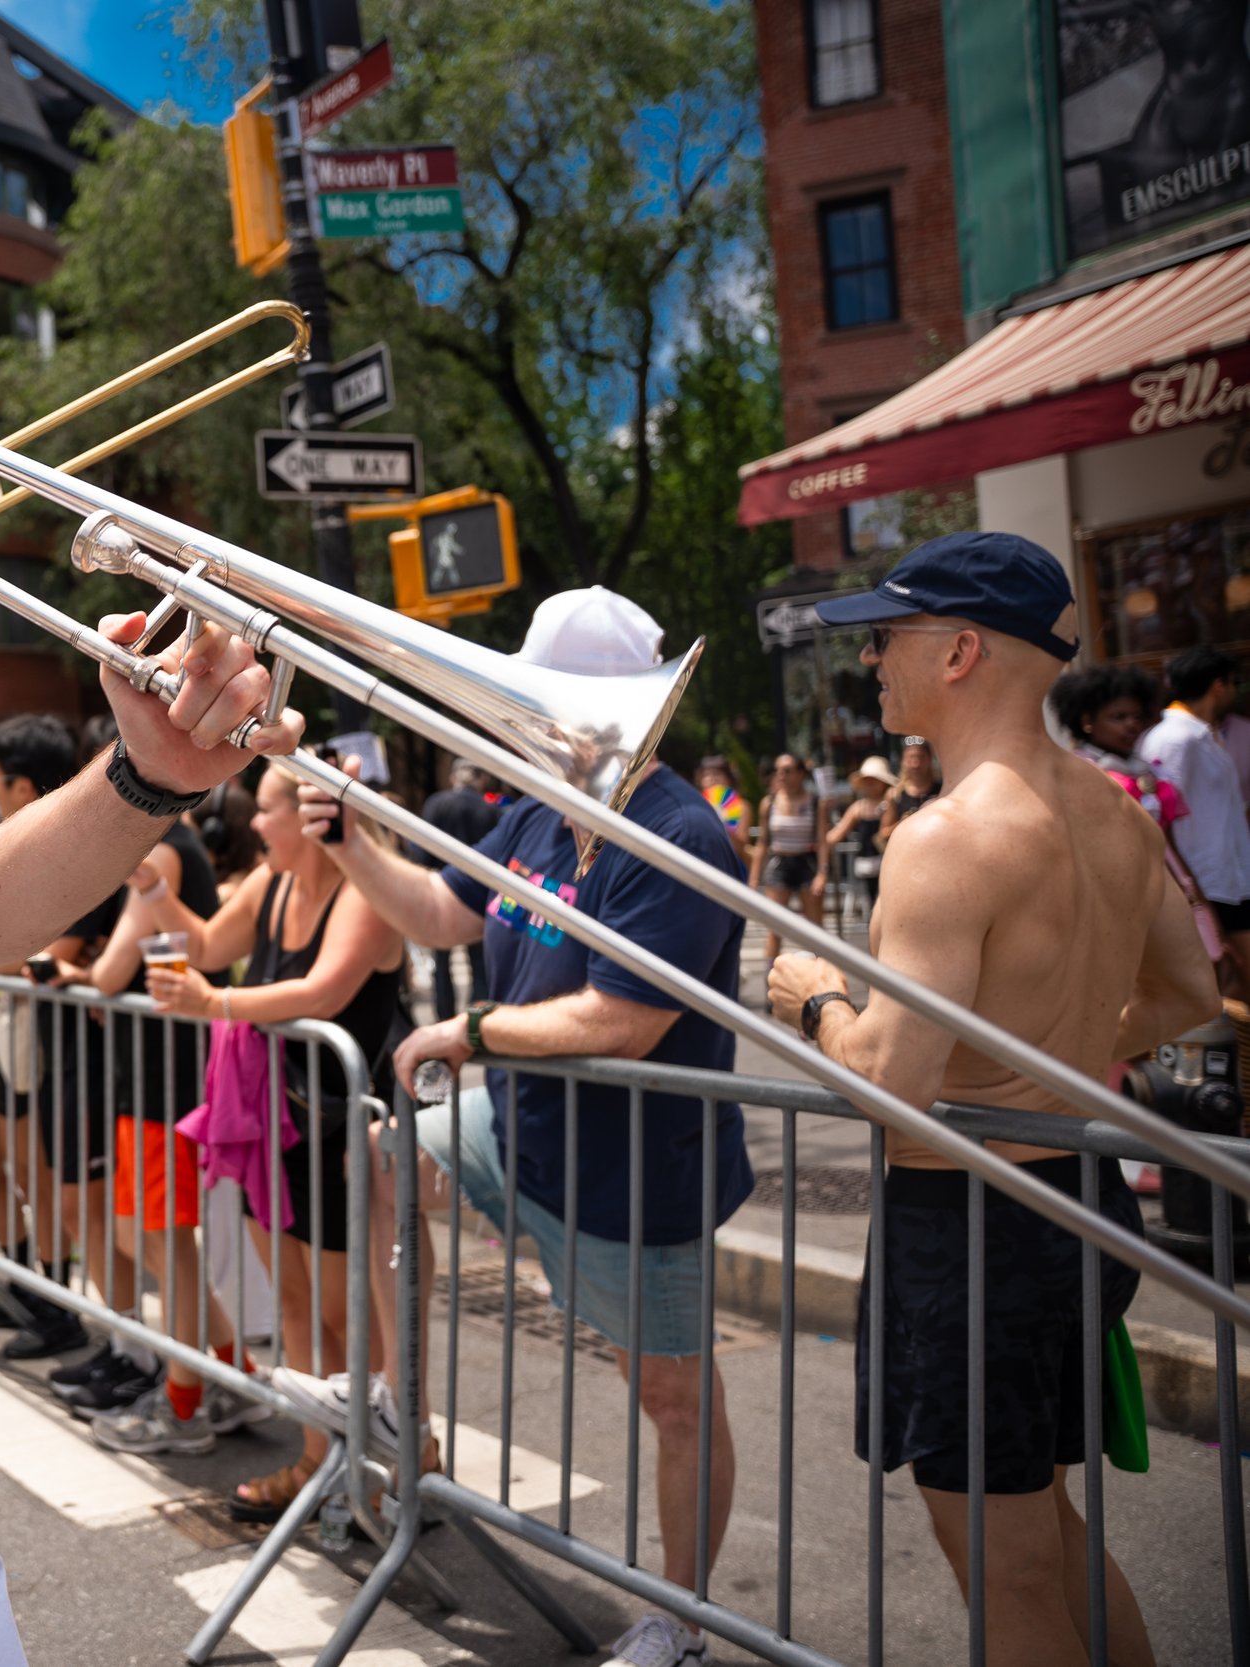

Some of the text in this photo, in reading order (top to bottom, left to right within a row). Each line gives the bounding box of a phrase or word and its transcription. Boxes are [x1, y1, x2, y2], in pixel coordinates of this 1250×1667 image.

[318, 153, 429, 191] Waverly Pl
[285, 453, 398, 481] ONE WAY
[788, 463, 868, 500] COFFEE
